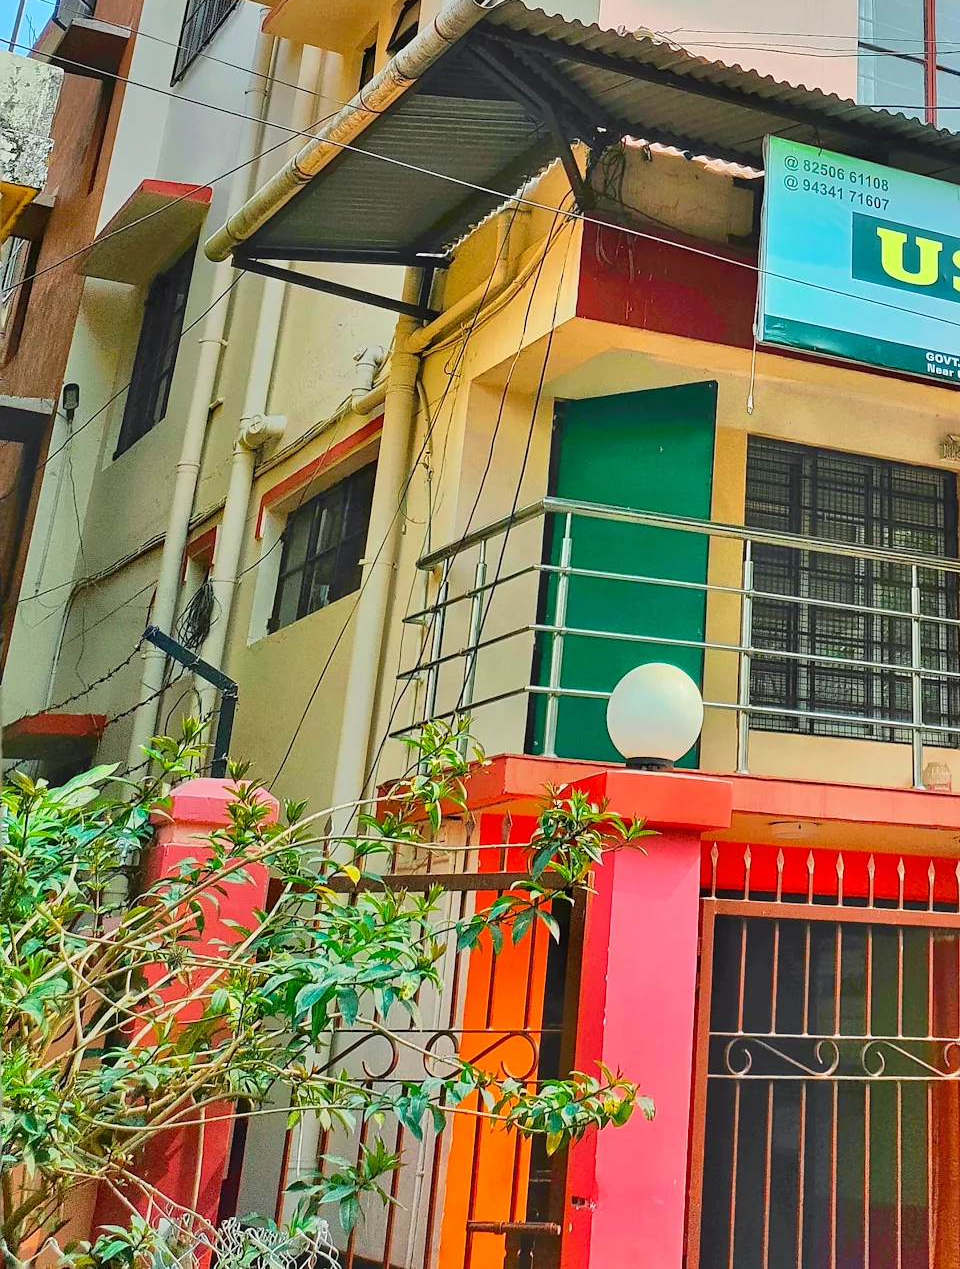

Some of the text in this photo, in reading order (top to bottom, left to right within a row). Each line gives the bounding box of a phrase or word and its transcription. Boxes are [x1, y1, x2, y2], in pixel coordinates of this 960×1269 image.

[803, 159, 845, 181] 82506
[849, 171, 889, 192] 61108
[802, 178, 843, 200] 94341
[849, 190, 889, 211] 71607
[927, 363, 955, 377] Near
